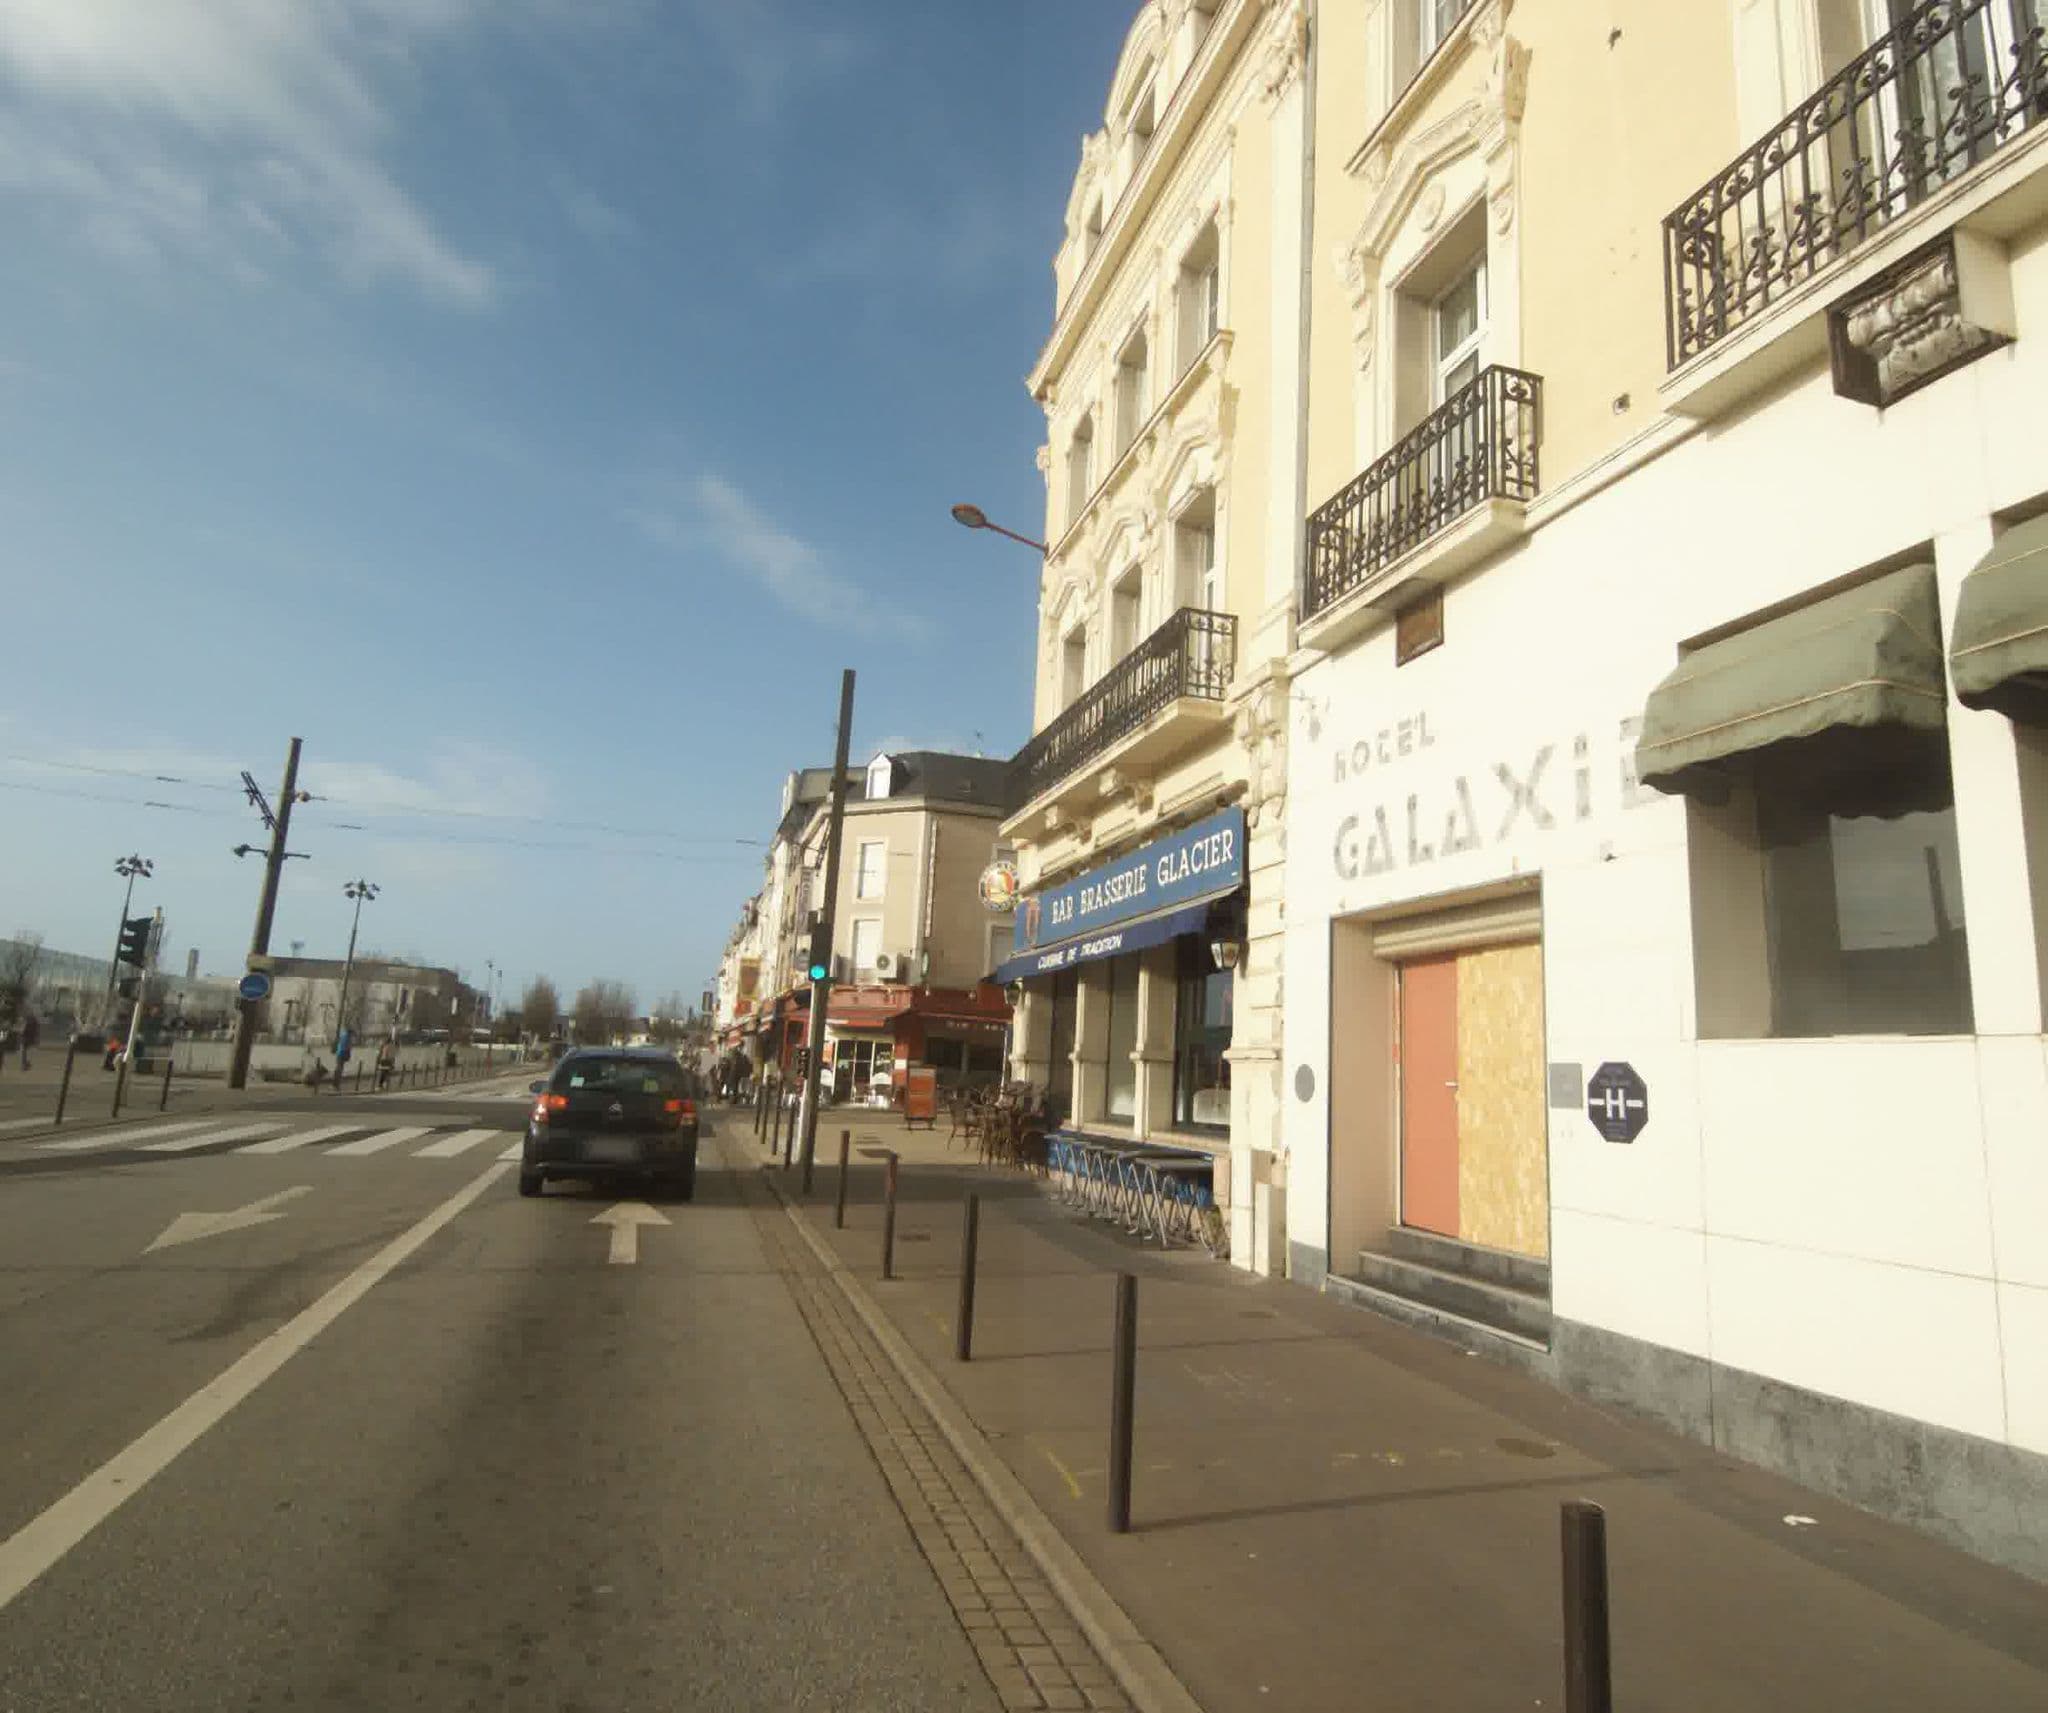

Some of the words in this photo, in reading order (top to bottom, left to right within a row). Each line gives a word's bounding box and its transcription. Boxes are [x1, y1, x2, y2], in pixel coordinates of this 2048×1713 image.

[1333, 711, 1436, 783] HOTEL
[1052, 895, 1074, 924] BAR
[1080, 863, 1148, 915] BRASSERIE
[1157, 829, 1234, 887] GLACIER
